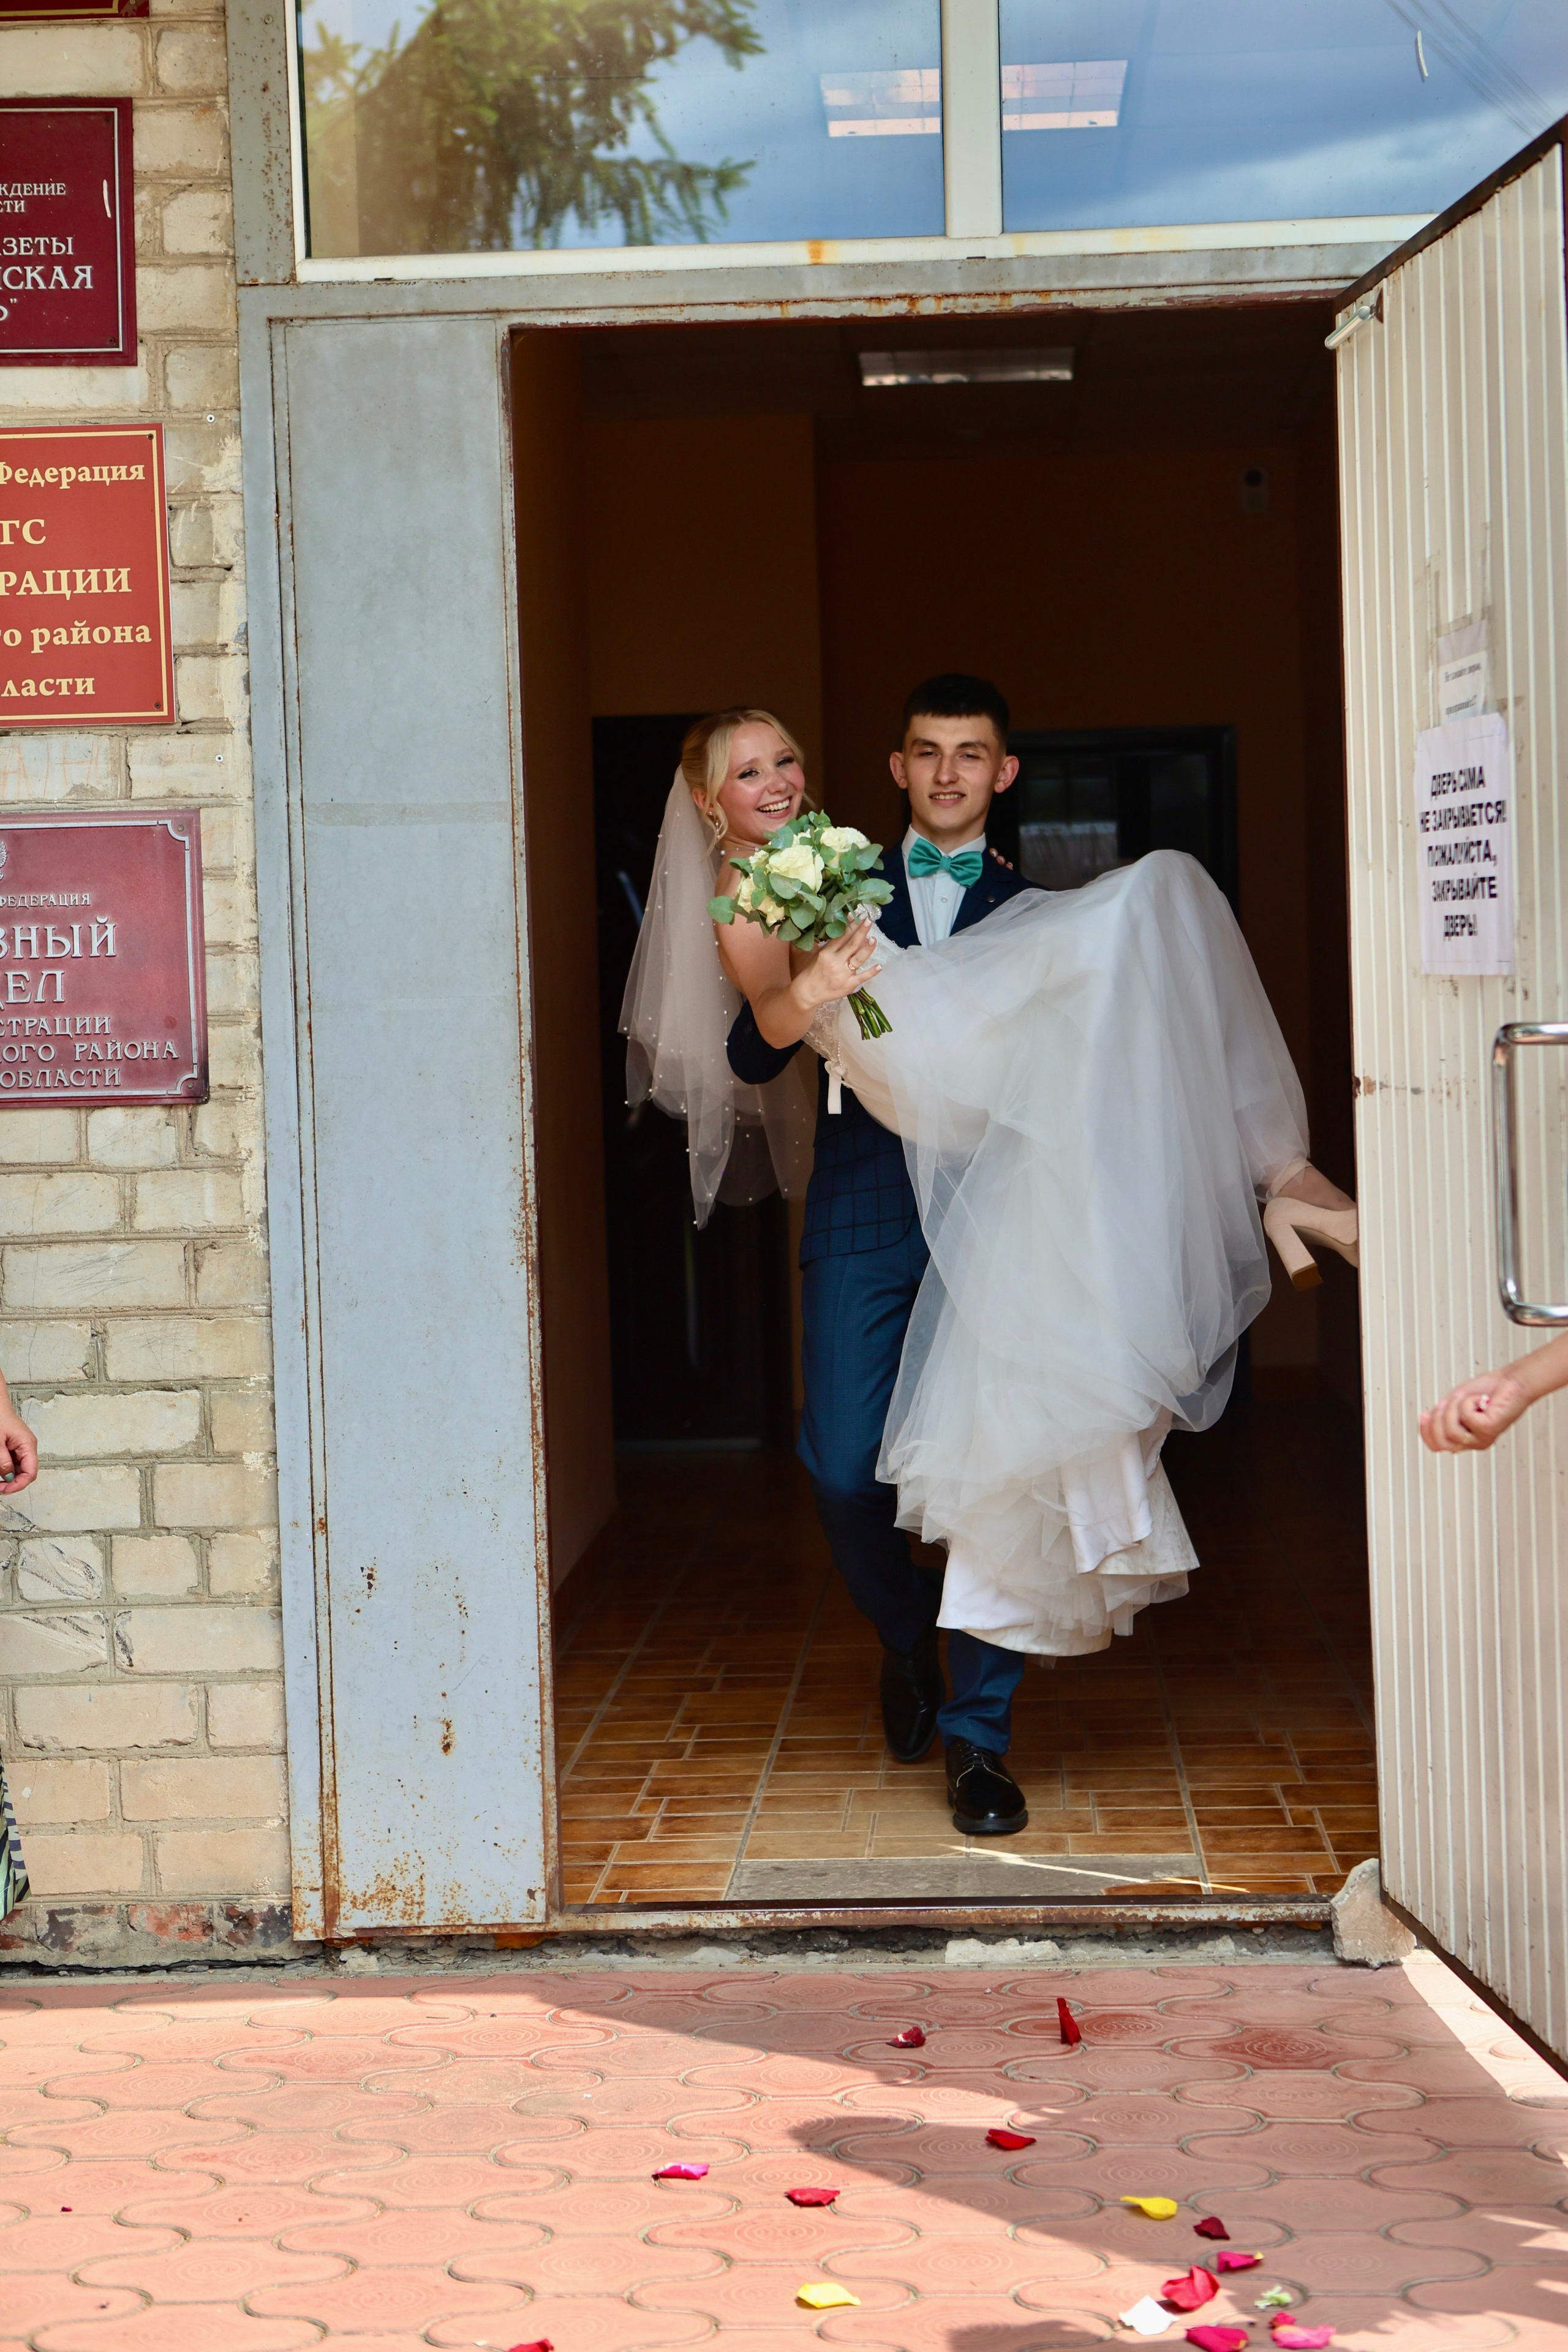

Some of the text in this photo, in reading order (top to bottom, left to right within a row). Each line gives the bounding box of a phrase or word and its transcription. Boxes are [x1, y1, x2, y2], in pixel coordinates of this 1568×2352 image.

[0, 237, 74, 255] ЗЕТЫ
[0, 266, 93, 290] СКАЯ
[0, 568, 132, 600] РАЦИИ
[0, 620, 152, 654] о района
[1, 677, 96, 697] ласти
[1430, 771, 1457, 801] ДВЕРЬ
[1419, 799, 1507, 834] НЕ ЗАКРЫВАЕТСЯ!
[1427, 836, 1498, 867] ПОЖАЛУЙСТА,
[1432, 872, 1498, 902] ЗАКРЫВАЙТЕ
[1443, 914, 1478, 942] ДВЕРЬ!
[0, 971, 66, 1011] ЕЛ
[0, 1039, 179, 1063] ОГО РАЙОНА
[0, 1068, 121, 1088] ОБЛАСТИ
